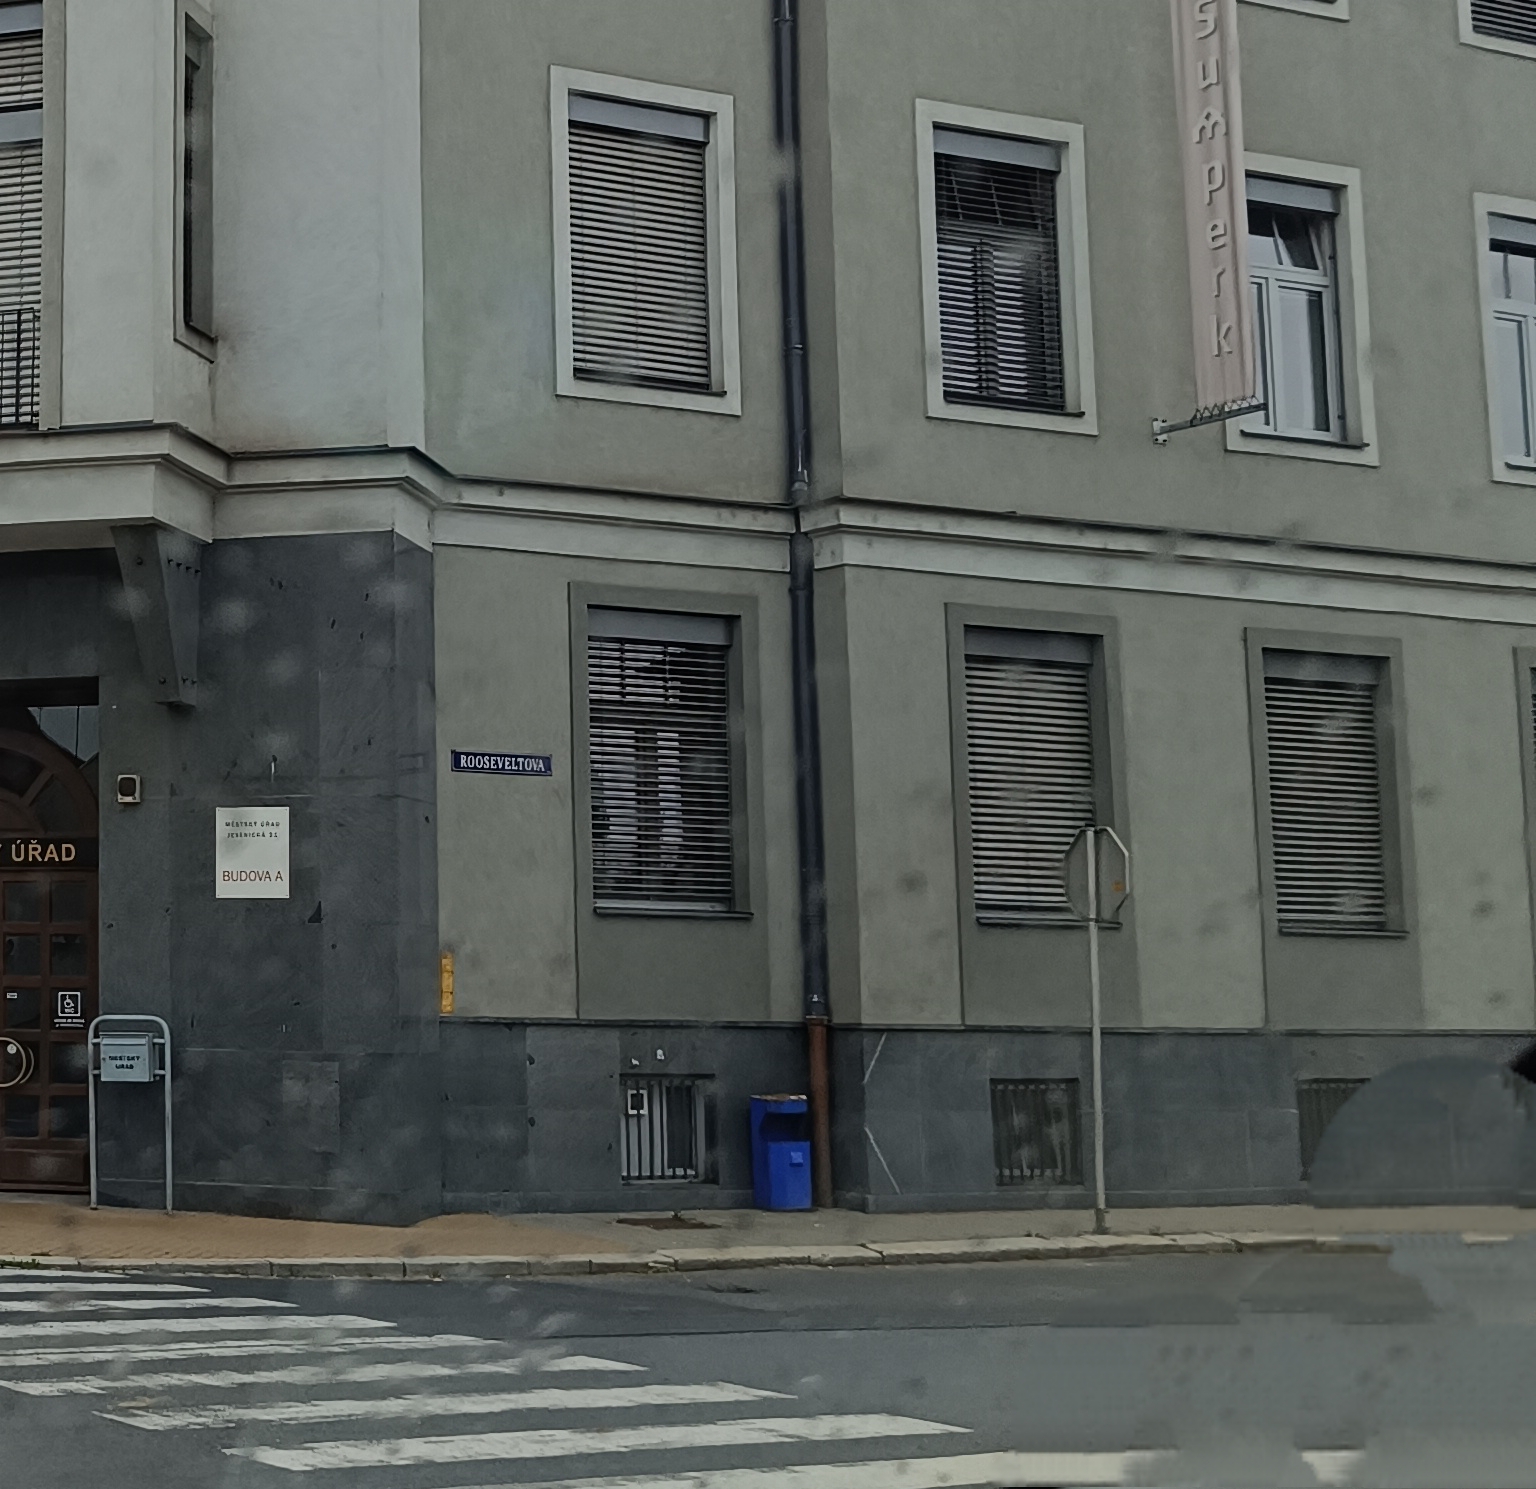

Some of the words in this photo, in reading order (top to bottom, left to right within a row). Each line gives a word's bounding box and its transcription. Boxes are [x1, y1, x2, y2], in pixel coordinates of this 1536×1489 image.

[460, 754, 546, 772] ROOSEVELTOVA
[11, 839, 76, 862] ÚŘAD
[222, 870, 272, 882] BUDOVA
[275, 870, 283, 882] A
